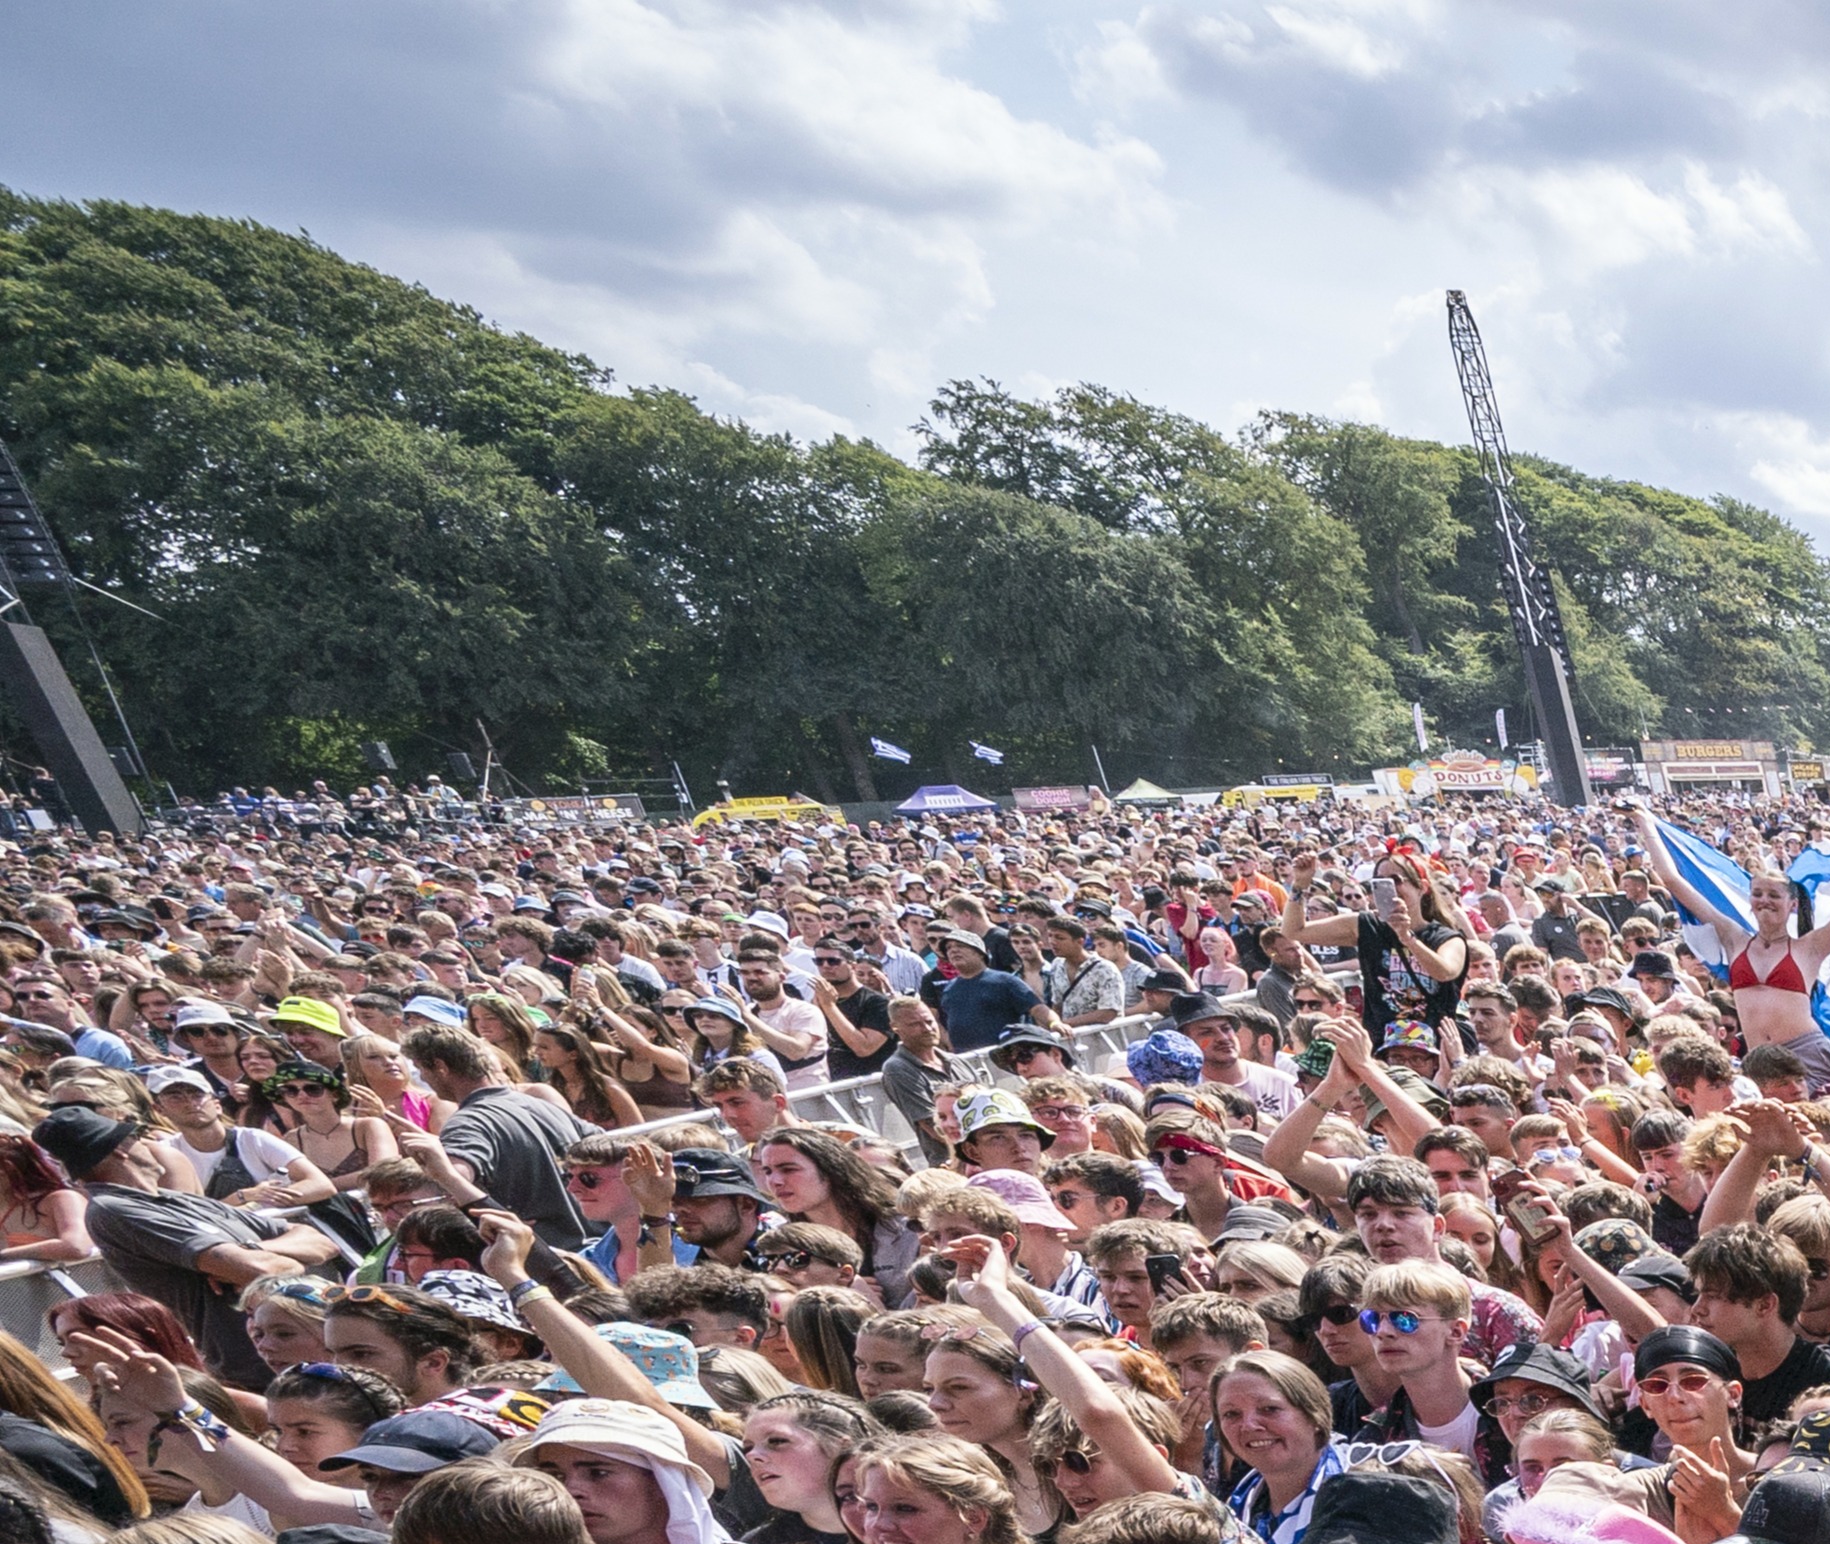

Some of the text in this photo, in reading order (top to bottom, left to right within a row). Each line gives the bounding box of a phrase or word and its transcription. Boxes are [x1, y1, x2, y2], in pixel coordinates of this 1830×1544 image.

[1675, 744, 1744, 759] BURGERS
[1433, 769, 1503, 784] DONUTS
[1031, 789, 1071, 798] COOKIE
[1035, 797, 1071, 805] DOUGH
[522, 809, 558, 821] MAC
